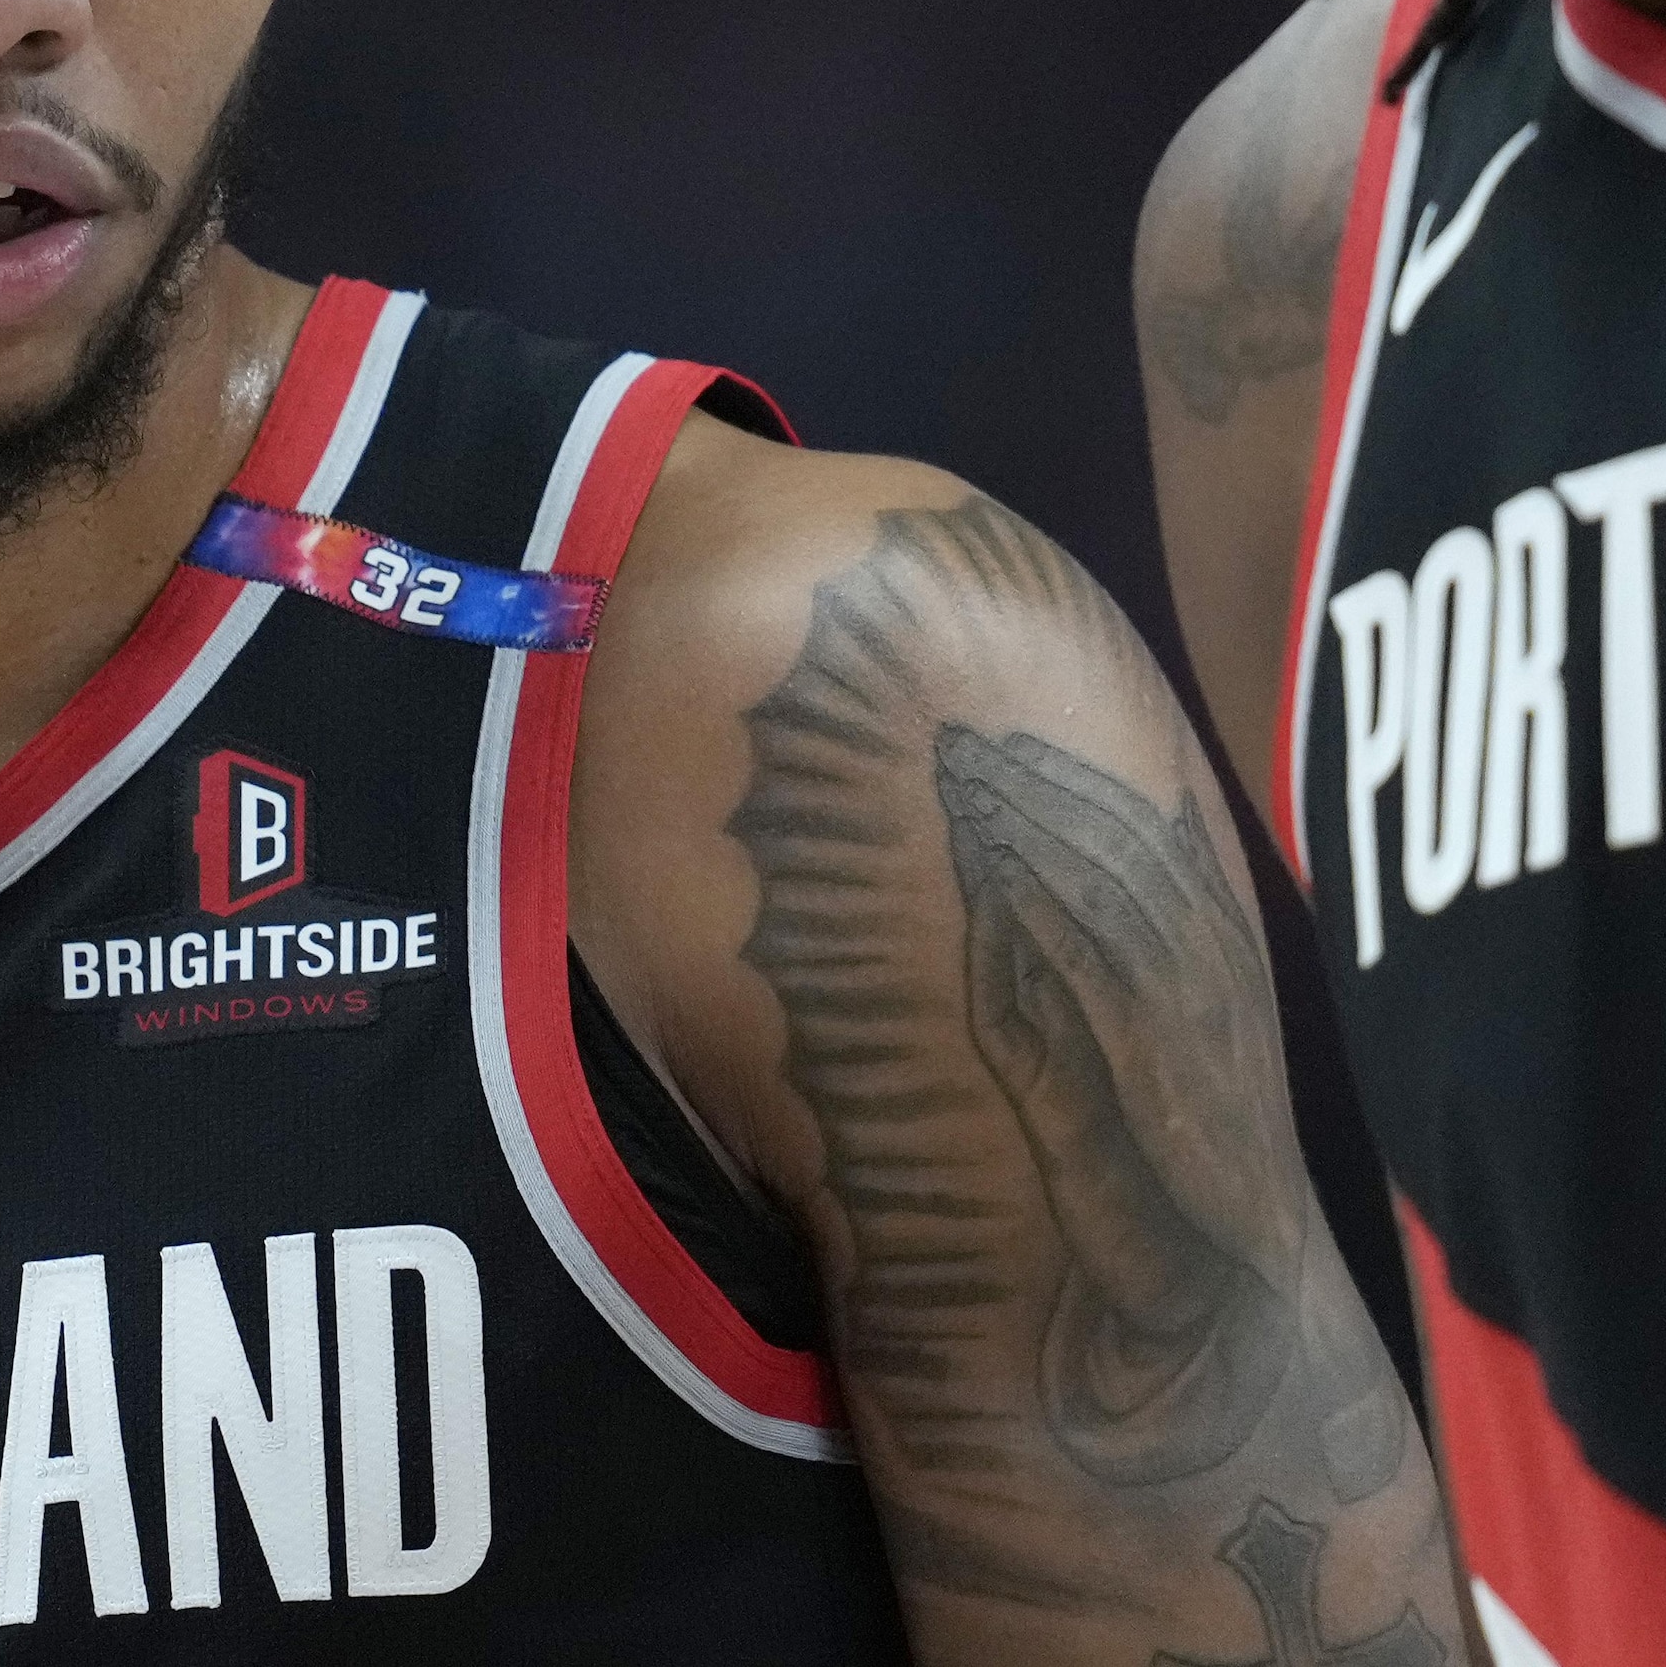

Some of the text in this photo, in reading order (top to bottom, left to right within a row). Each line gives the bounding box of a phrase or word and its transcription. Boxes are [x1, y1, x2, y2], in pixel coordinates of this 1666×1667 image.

[350, 546, 462, 627] 32
[240, 781, 287, 882] B
[62, 912, 437, 1000] BRIGHTSIDE
[134, 989, 369, 1032] WINDOWS
